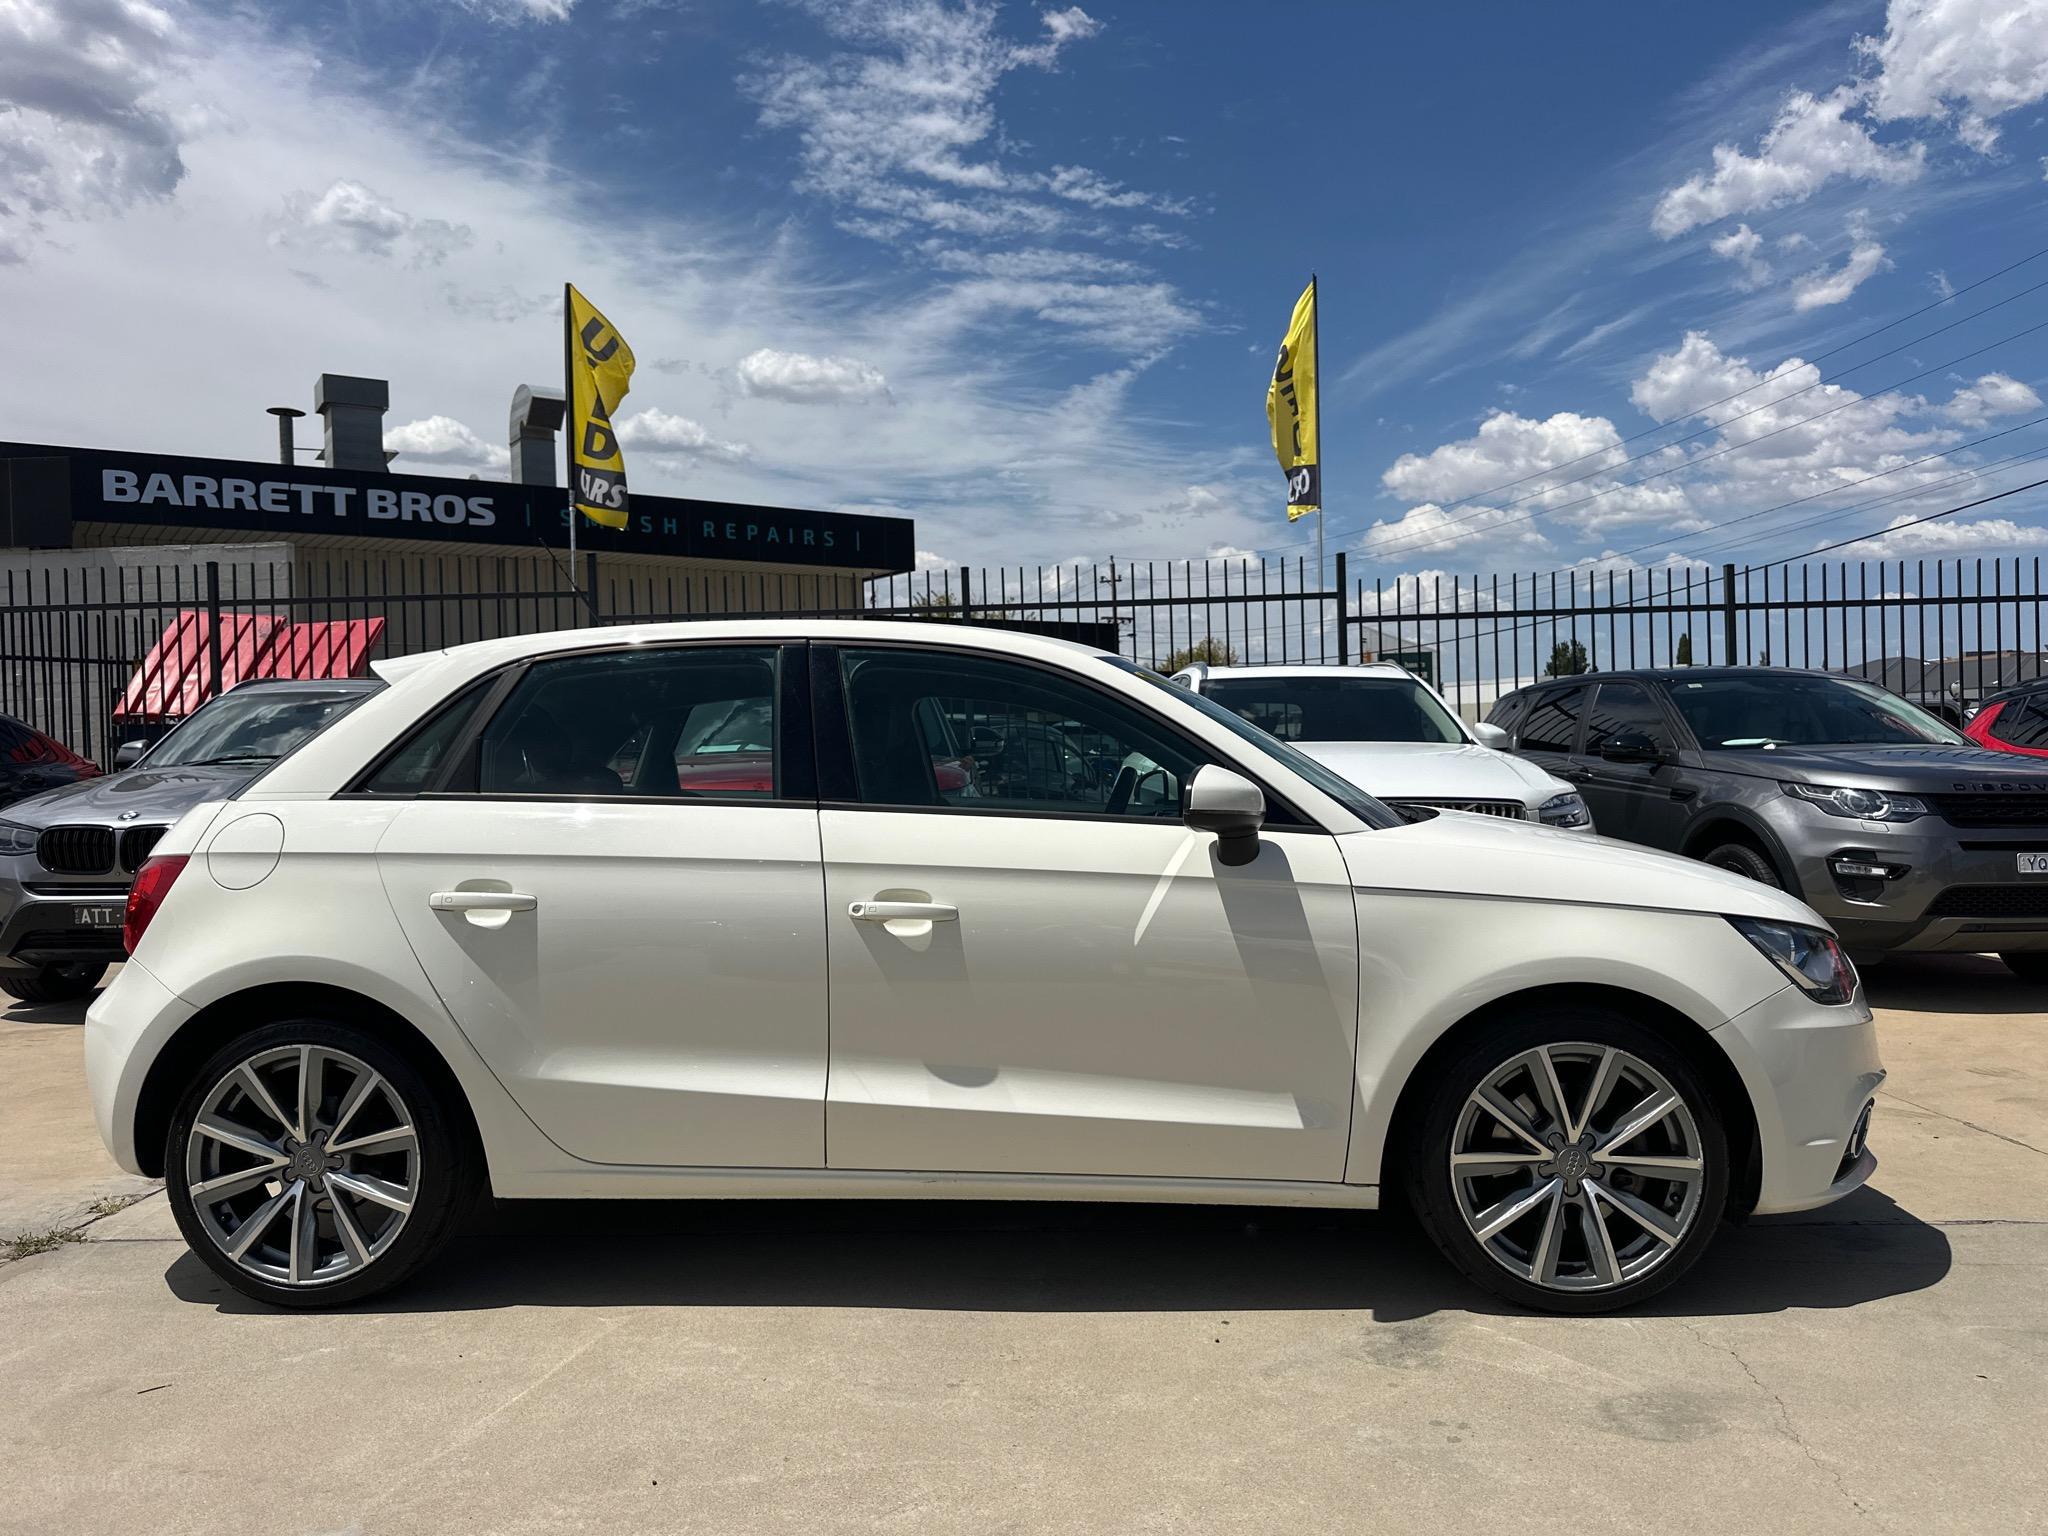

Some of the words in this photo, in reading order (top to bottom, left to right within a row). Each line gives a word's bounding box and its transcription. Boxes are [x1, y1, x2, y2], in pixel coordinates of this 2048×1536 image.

[580, 316, 620, 461] UD
[102, 469, 356, 517] BARRETT
[367, 488, 496, 527] BROS
[560, 508, 678, 535] SSH
[703, 520, 835, 547] REPAIRS
